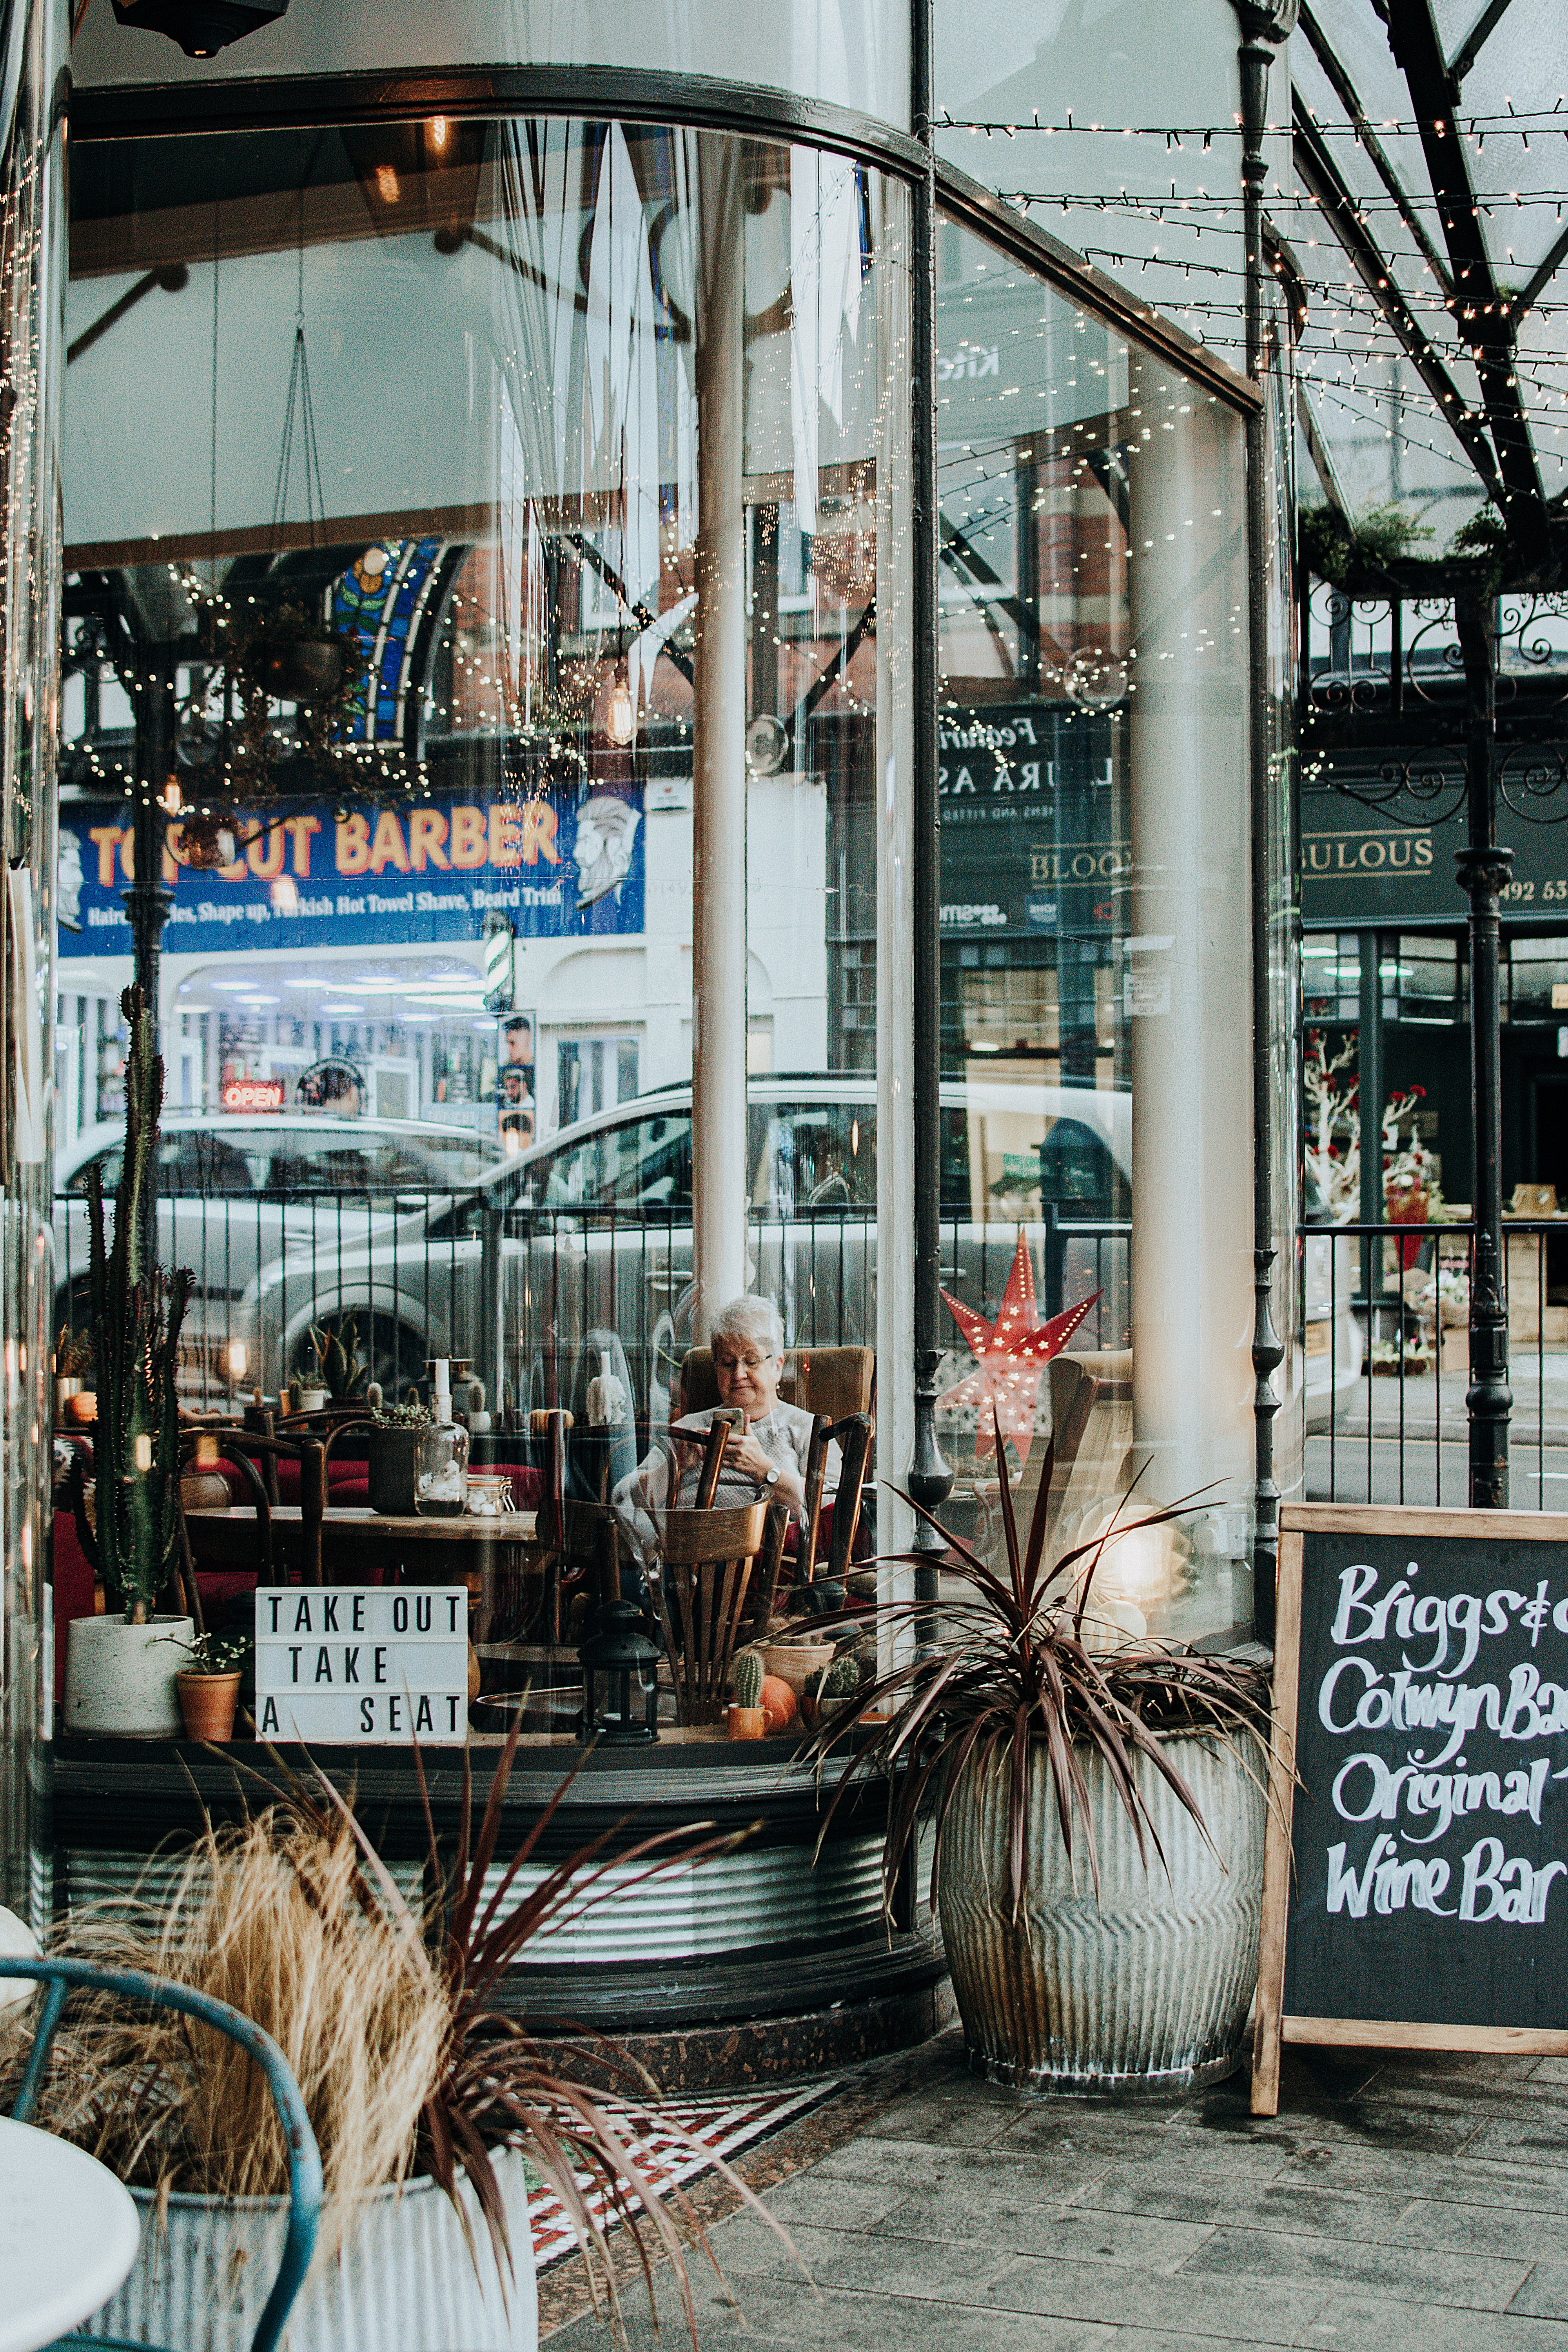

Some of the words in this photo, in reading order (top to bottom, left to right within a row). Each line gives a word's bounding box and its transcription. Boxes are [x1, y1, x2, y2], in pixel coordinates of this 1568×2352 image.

[335, 801, 562, 876] BARBER
[197, 902, 242, 925] Shape
[245, 903, 270, 924] up,
[337, 896, 366, 916] Hot
[368, 892, 414, 913] Towel
[416, 891, 469, 912] Shave,
[472, 887, 521, 910] Beard
[524, 887, 561, 907] Trim
[225, 1088, 281, 1106] OPEN
[268, 1595, 365, 1632] TAKE
[393, 1595, 460, 1632] OUT
[1331, 1562, 1526, 1678] Briggs
[289, 1646, 387, 1683] TAKE
[262, 1696, 279, 1732] A
[360, 1695, 460, 1733] SEAT
[1318, 1656, 1500, 1769] Colwyn
[1332, 1752, 1550, 1844] Original
[1327, 1833, 1457, 1918] Wine
[1459, 1837, 1567, 1923] Bar
